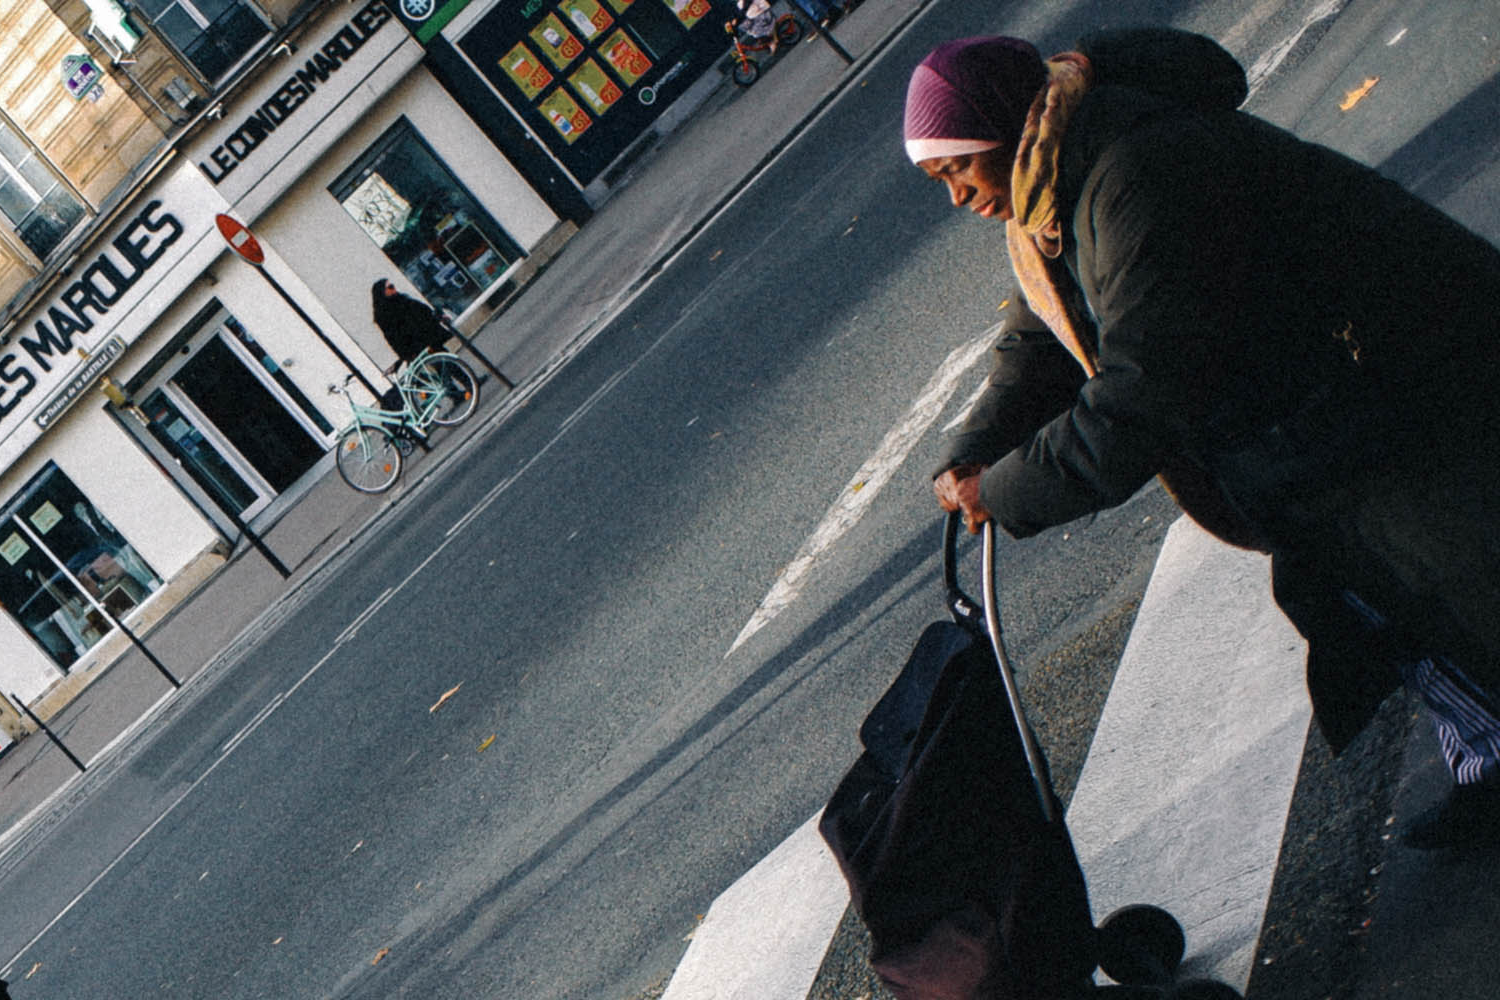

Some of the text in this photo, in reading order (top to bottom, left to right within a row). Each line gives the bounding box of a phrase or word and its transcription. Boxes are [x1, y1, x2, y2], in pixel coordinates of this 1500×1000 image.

[199, 145, 239, 185] LE
[260, 75, 311, 127] DES
[81, 352, 110, 384] BASTILLE
